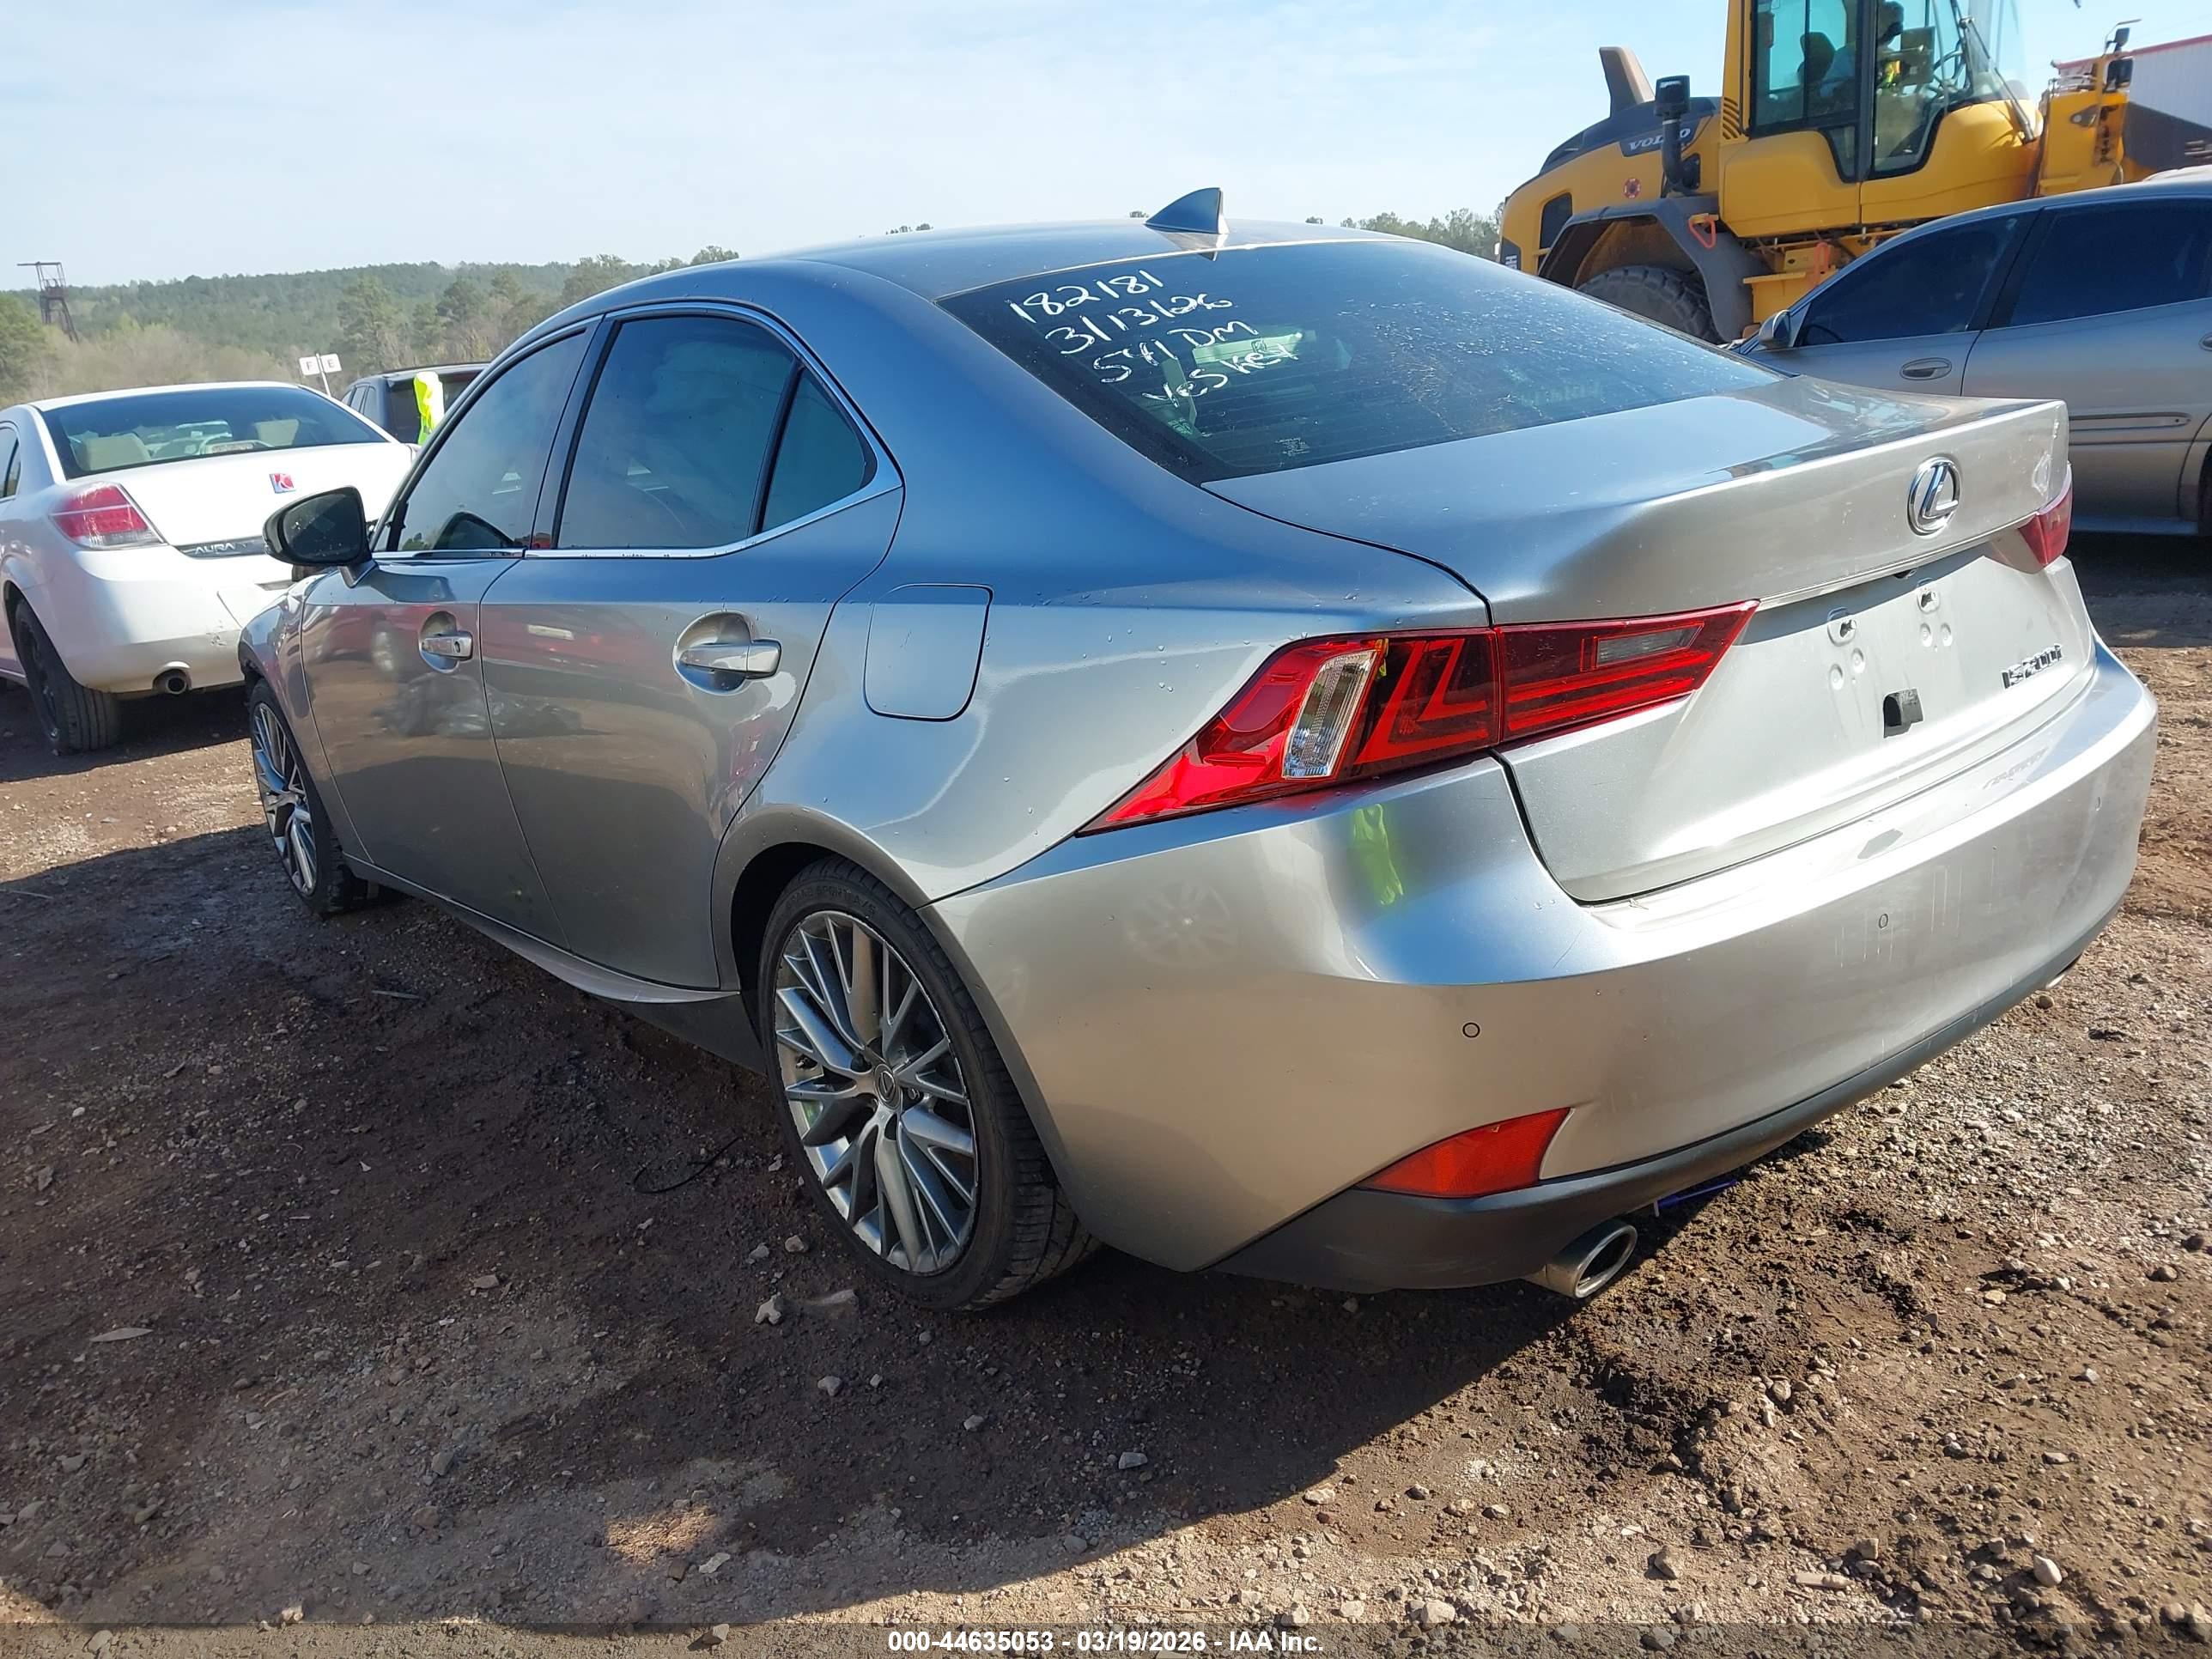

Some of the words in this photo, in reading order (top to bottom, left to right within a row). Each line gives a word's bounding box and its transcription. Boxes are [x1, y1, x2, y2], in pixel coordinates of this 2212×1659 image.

[1629, 128, 1691, 151] VOLO
[1008, 269, 1164, 324] 182181
[1166, 319, 1260, 348] DM
[194, 542, 236, 555] AURA
